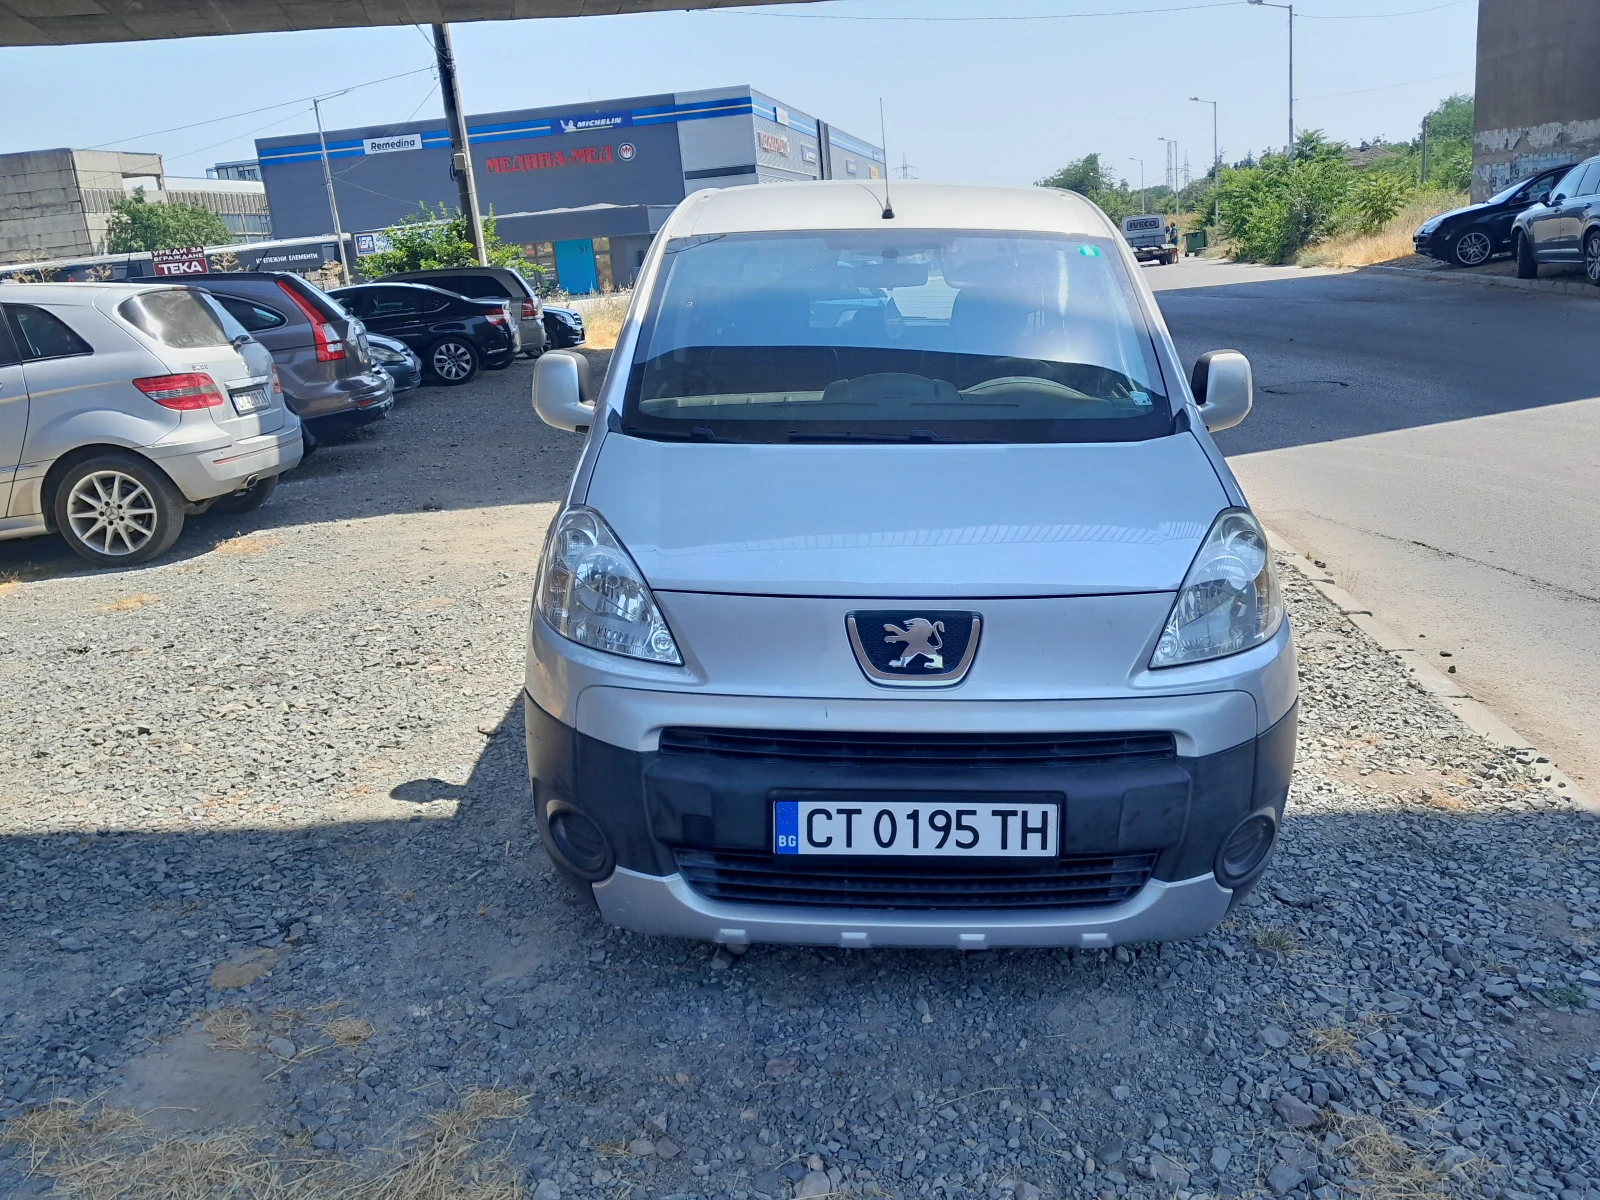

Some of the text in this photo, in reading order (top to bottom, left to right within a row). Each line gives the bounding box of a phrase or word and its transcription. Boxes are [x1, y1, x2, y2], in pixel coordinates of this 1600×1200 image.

[577, 116, 622, 128] MICHELIN
[370, 139, 415, 150] Remedina
[485, 145, 614, 174] МЕДИНА-МЕД
[1130, 220, 1157, 229] IVECO
[152, 248, 187, 256] УРЕДИ
[153, 253, 204, 262] ВГРАЖДАНЕ
[158, 261, 203, 275] TEKA
[806, 808, 1049, 850] CT 0195 TH
[778, 834, 797, 847] BG
